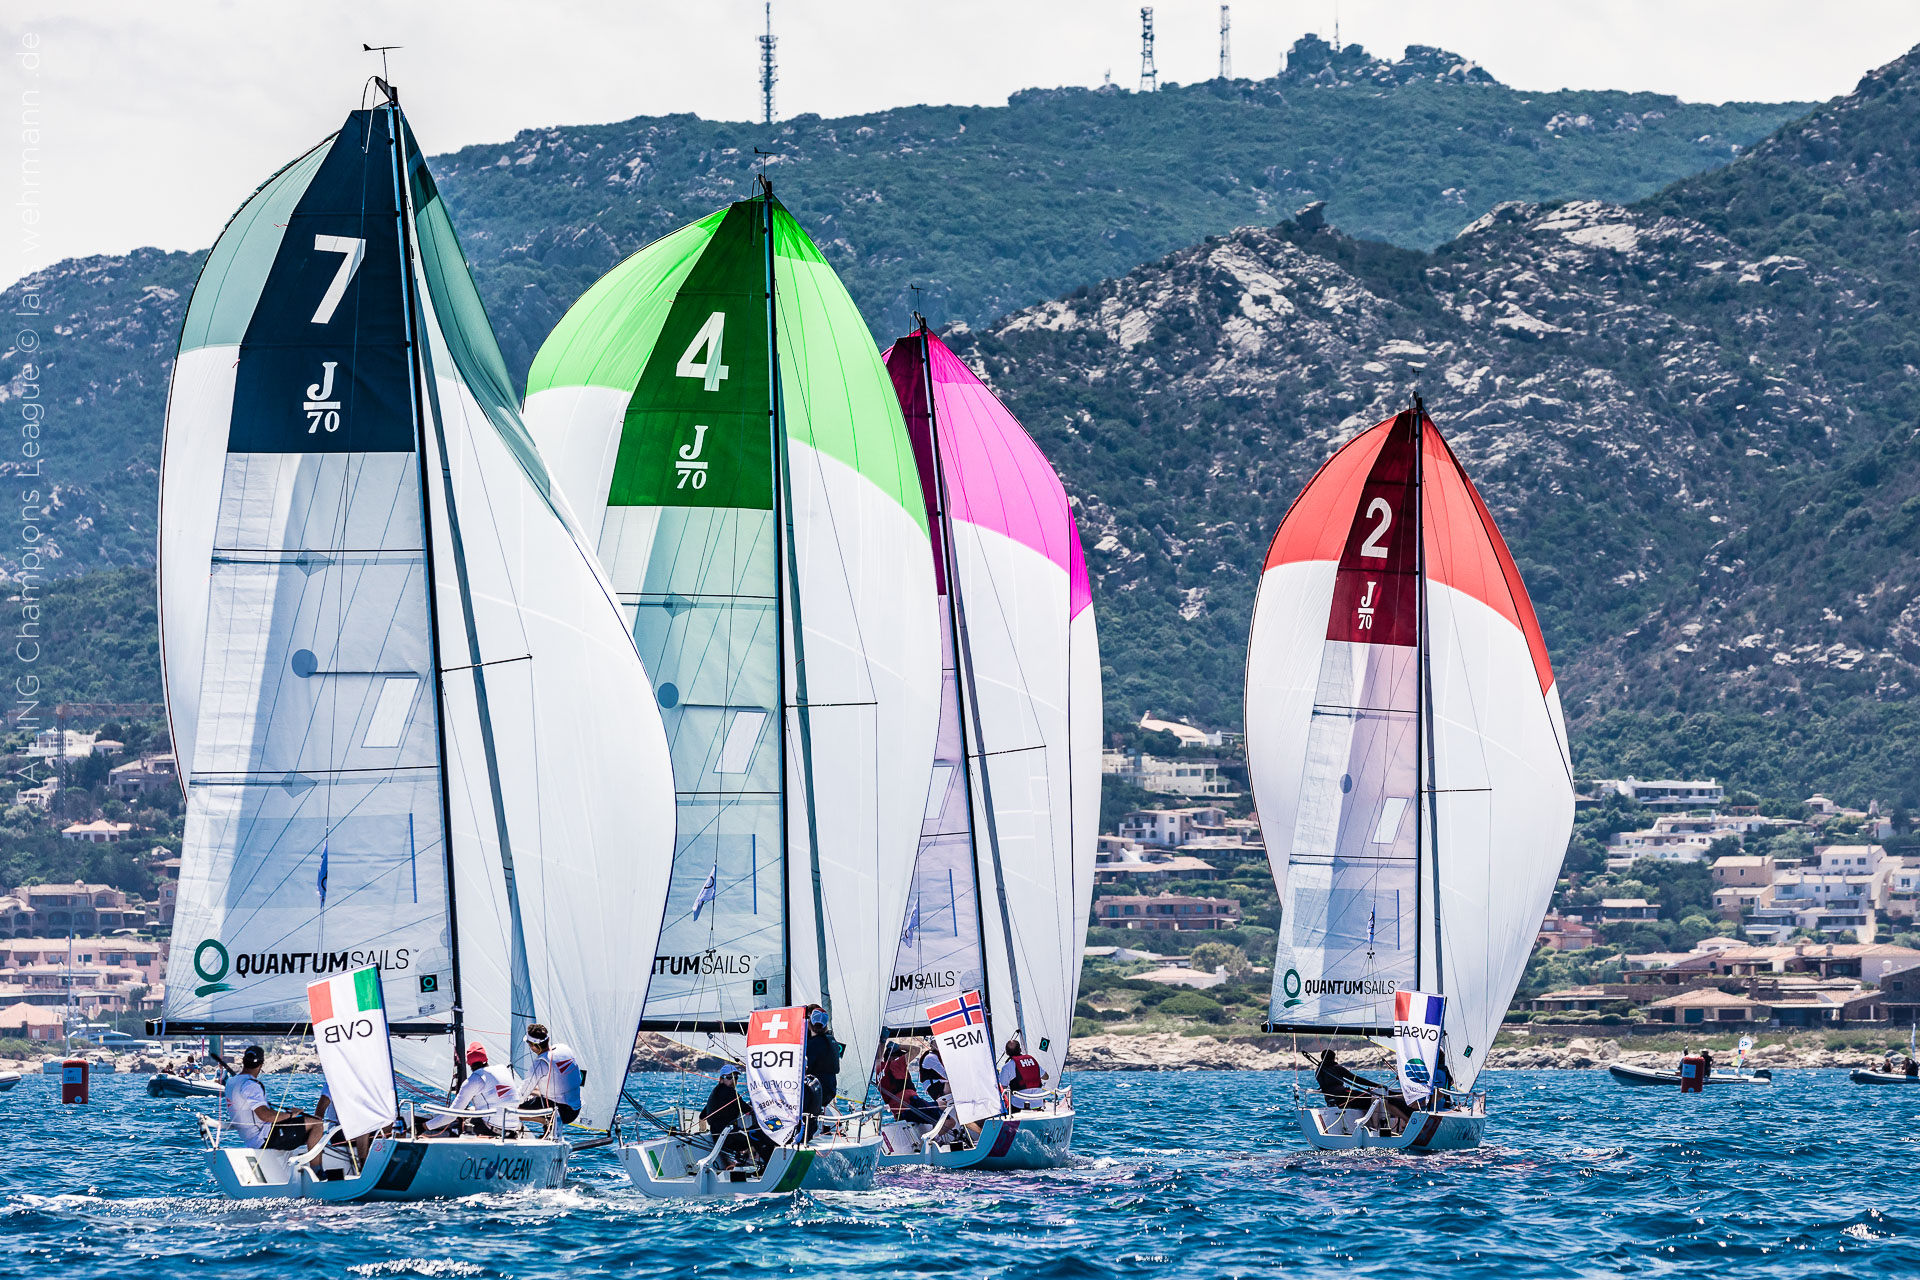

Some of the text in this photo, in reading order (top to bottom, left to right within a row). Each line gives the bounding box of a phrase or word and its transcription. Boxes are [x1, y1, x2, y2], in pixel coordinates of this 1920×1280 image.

[310, 233, 366, 324] 7
[675, 311, 729, 392] 4
[306, 361, 338, 401] J
[306, 410, 340, 434] 70
[678, 424, 709, 460] J
[676, 469, 707, 490] 70
[1360, 497, 1393, 559] 2
[1360, 581, 1377, 608] J
[1357, 614, 1373, 630] 70
[459, 1157, 534, 1181] ONE OCEAN
